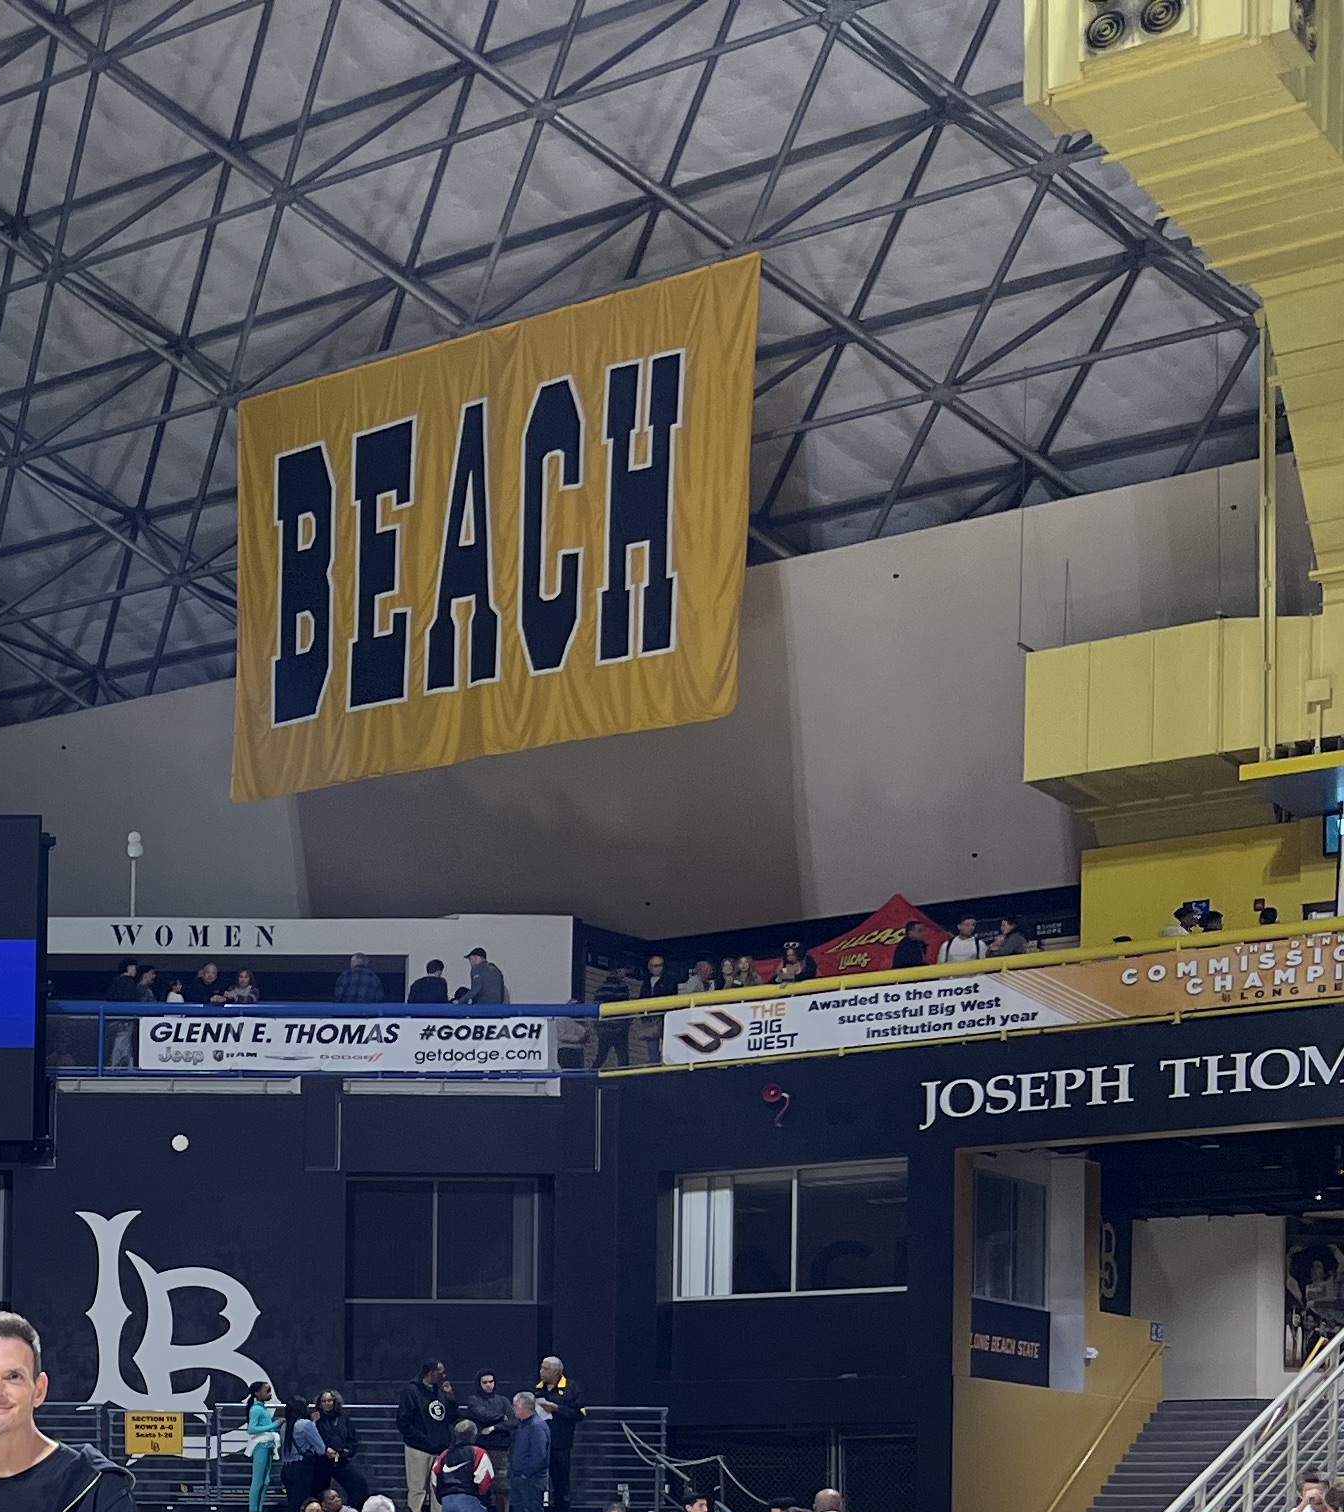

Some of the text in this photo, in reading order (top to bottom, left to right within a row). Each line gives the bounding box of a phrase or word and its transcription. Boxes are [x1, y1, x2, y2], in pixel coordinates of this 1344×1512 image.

[271, 348, 686, 728] BEACH
[110, 923, 275, 947] WOMEN
[1235, 943, 1273, 954] THE
[838, 952, 871, 970] LUCAS
[808, 983, 980, 1012] Awarded to the most
[1240, 986, 1300, 1000] LONG
[749, 1002, 786, 1019] THE
[837, 996, 1002, 1025] successful Big West
[150, 1022, 542, 1044] GLENN E. THOMAS #GOBEACH
[865, 1011, 1039, 1039] institution each year
[747, 1033, 799, 1052] WEST
[158, 1047, 204, 1065] Jeep
[414, 1048, 542, 1065] getdodge.com
[919, 1044, 1344, 1131] JOSEPH THOM
[131, 1415, 165, 1423] SECTION
